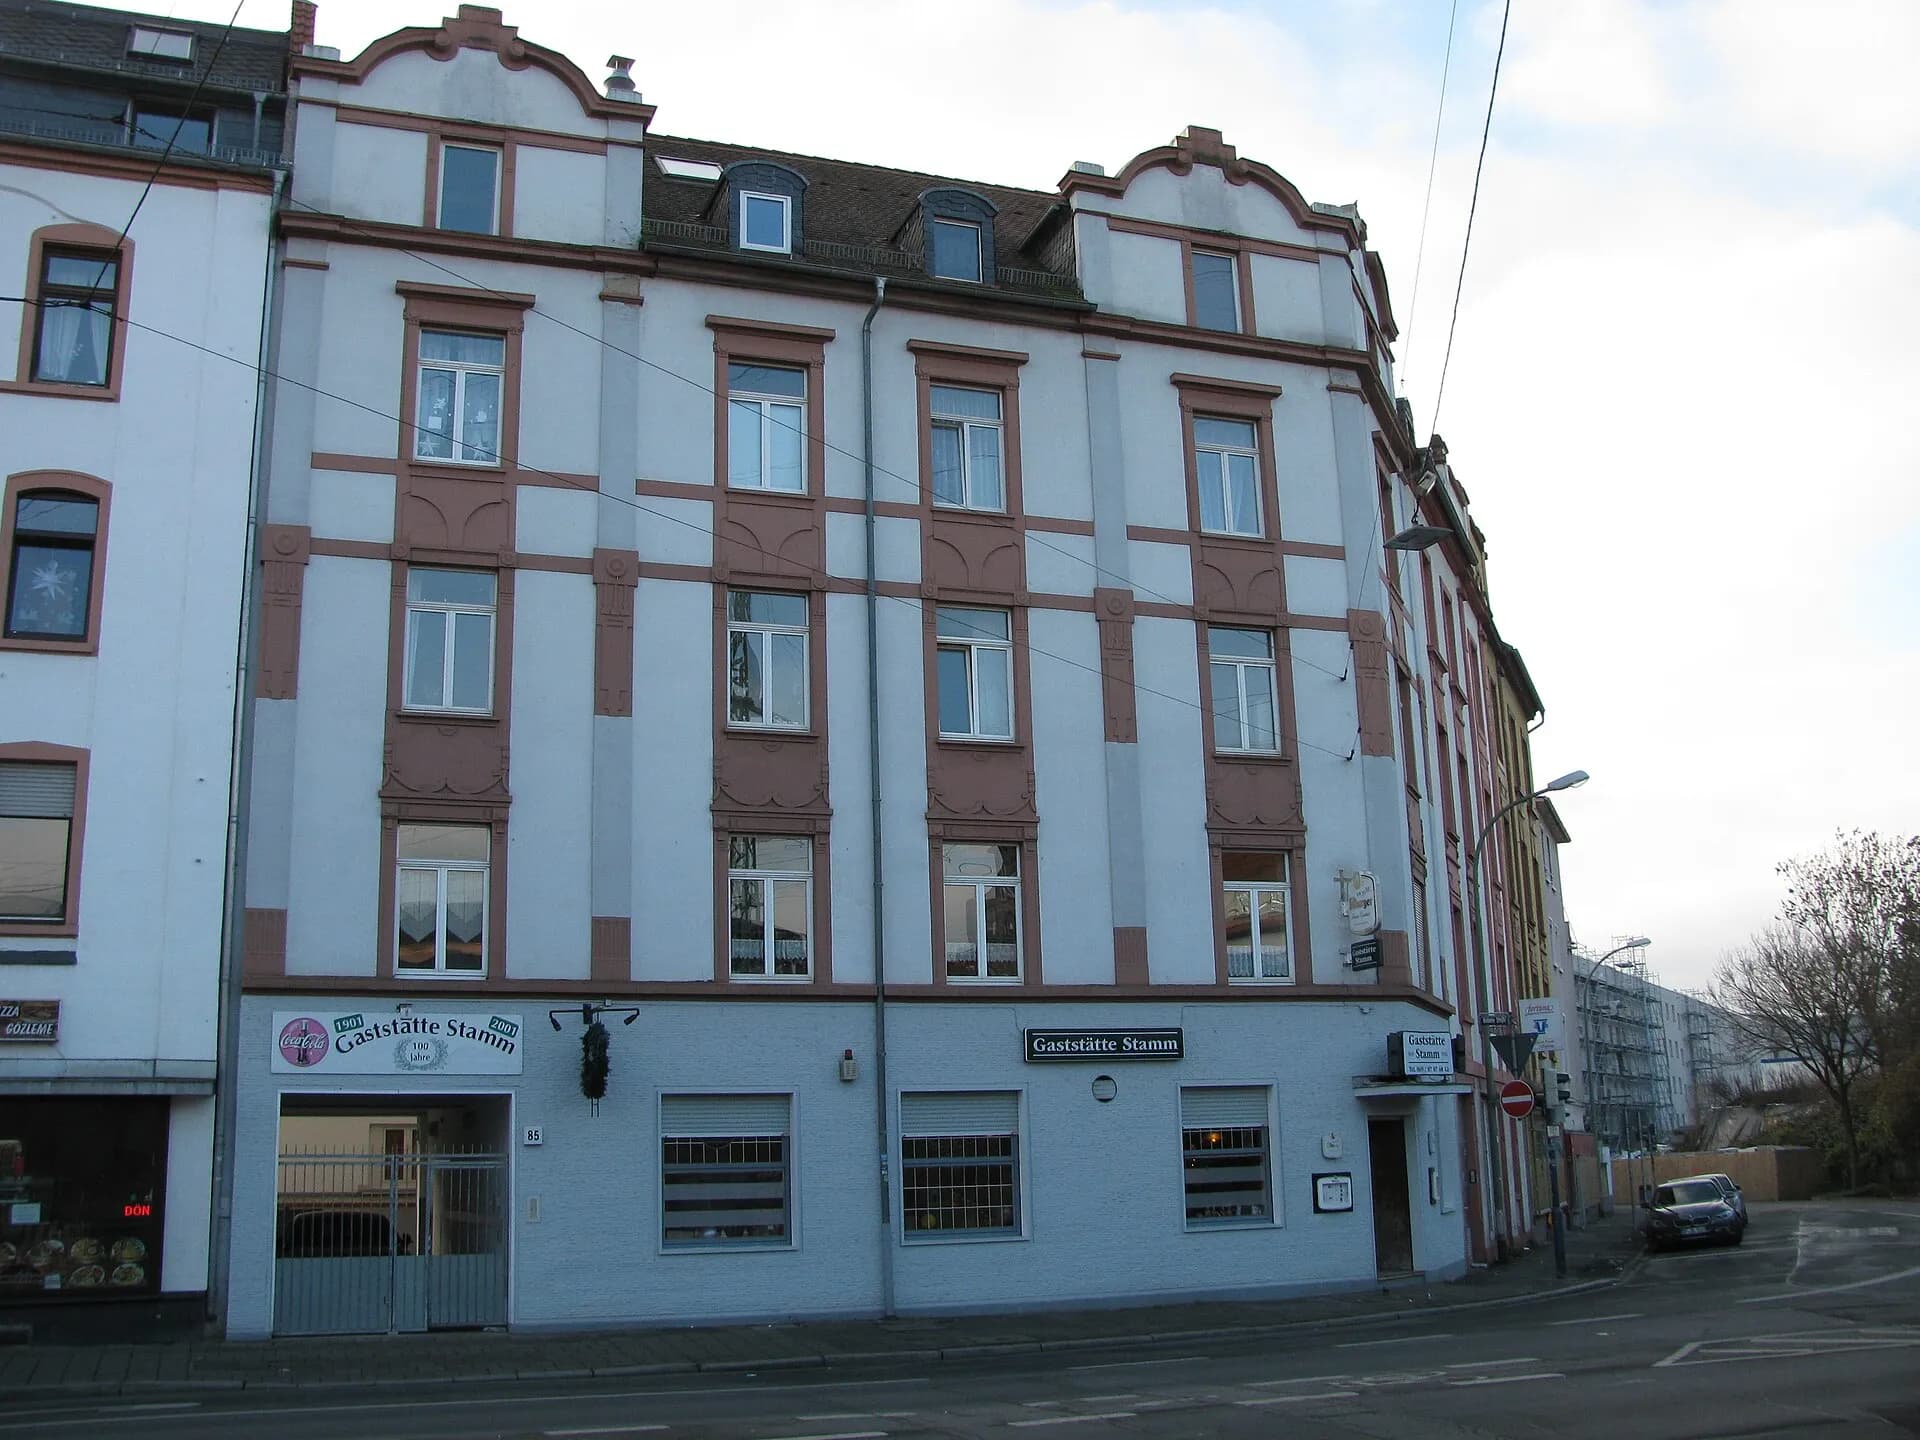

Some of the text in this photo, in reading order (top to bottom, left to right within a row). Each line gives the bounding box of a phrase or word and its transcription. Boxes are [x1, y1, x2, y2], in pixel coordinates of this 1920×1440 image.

[0, 1005, 20, 1017] ZZA
[335, 1017, 363, 1031] 1901
[490, 1018, 518, 1036] 2001
[335, 1017, 516, 1055] Gaststätte Stamm
[1408, 1034, 1446, 1046] Gaststätte
[412, 1041, 429, 1050] 100
[1032, 1036, 1179, 1052] Gaststätte Stamm
[409, 1052, 431, 1062] Jahre
[1415, 1048, 1441, 1059] Stamm
[527, 1129, 540, 1141] 85
